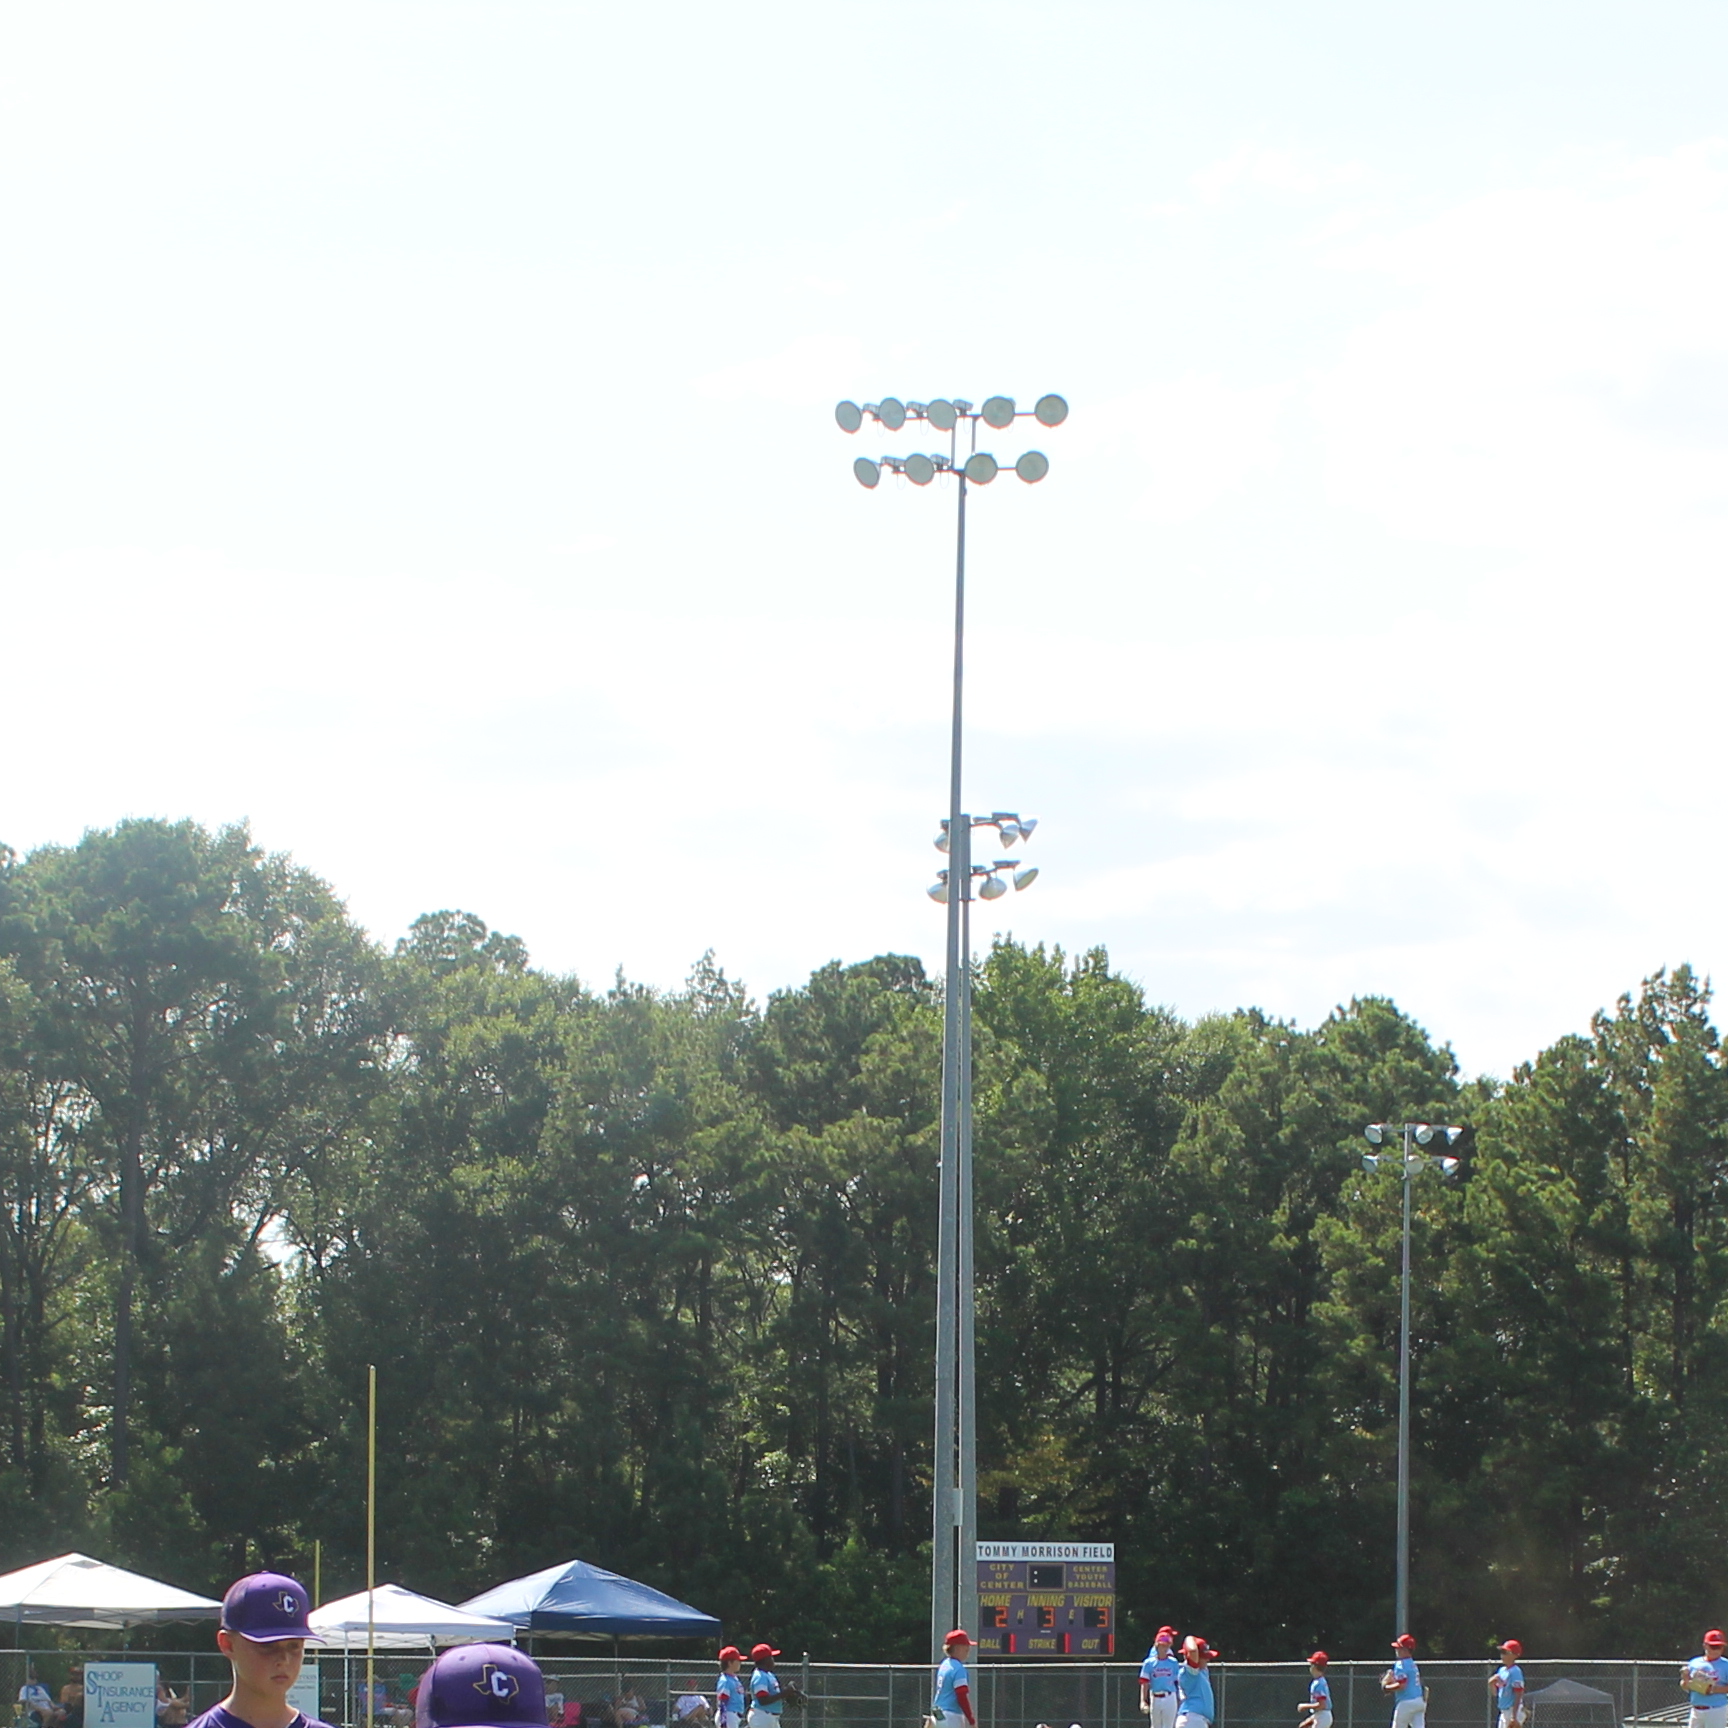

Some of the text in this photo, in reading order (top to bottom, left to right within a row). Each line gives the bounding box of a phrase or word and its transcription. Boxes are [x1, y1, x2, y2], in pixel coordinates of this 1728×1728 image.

[978, 1545, 1113, 1558] TOMMY MORRISON FIELD
[989, 1563, 1014, 1571] CITY
[995, 1572, 1009, 1580] OF
[283, 1595, 294, 1613] C
[980, 1594, 1113, 1607] HOME INNING VISITOR
[995, 1606, 1109, 1628] 2 3 3
[979, 1638, 1100, 1649] BALL STRIKE OUT
[86, 1671, 124, 1695] SHOOP
[491, 1671, 509, 1697] C
[97, 1685, 154, 1708] INSURANCE
[100, 1701, 147, 1722] AGENCY
